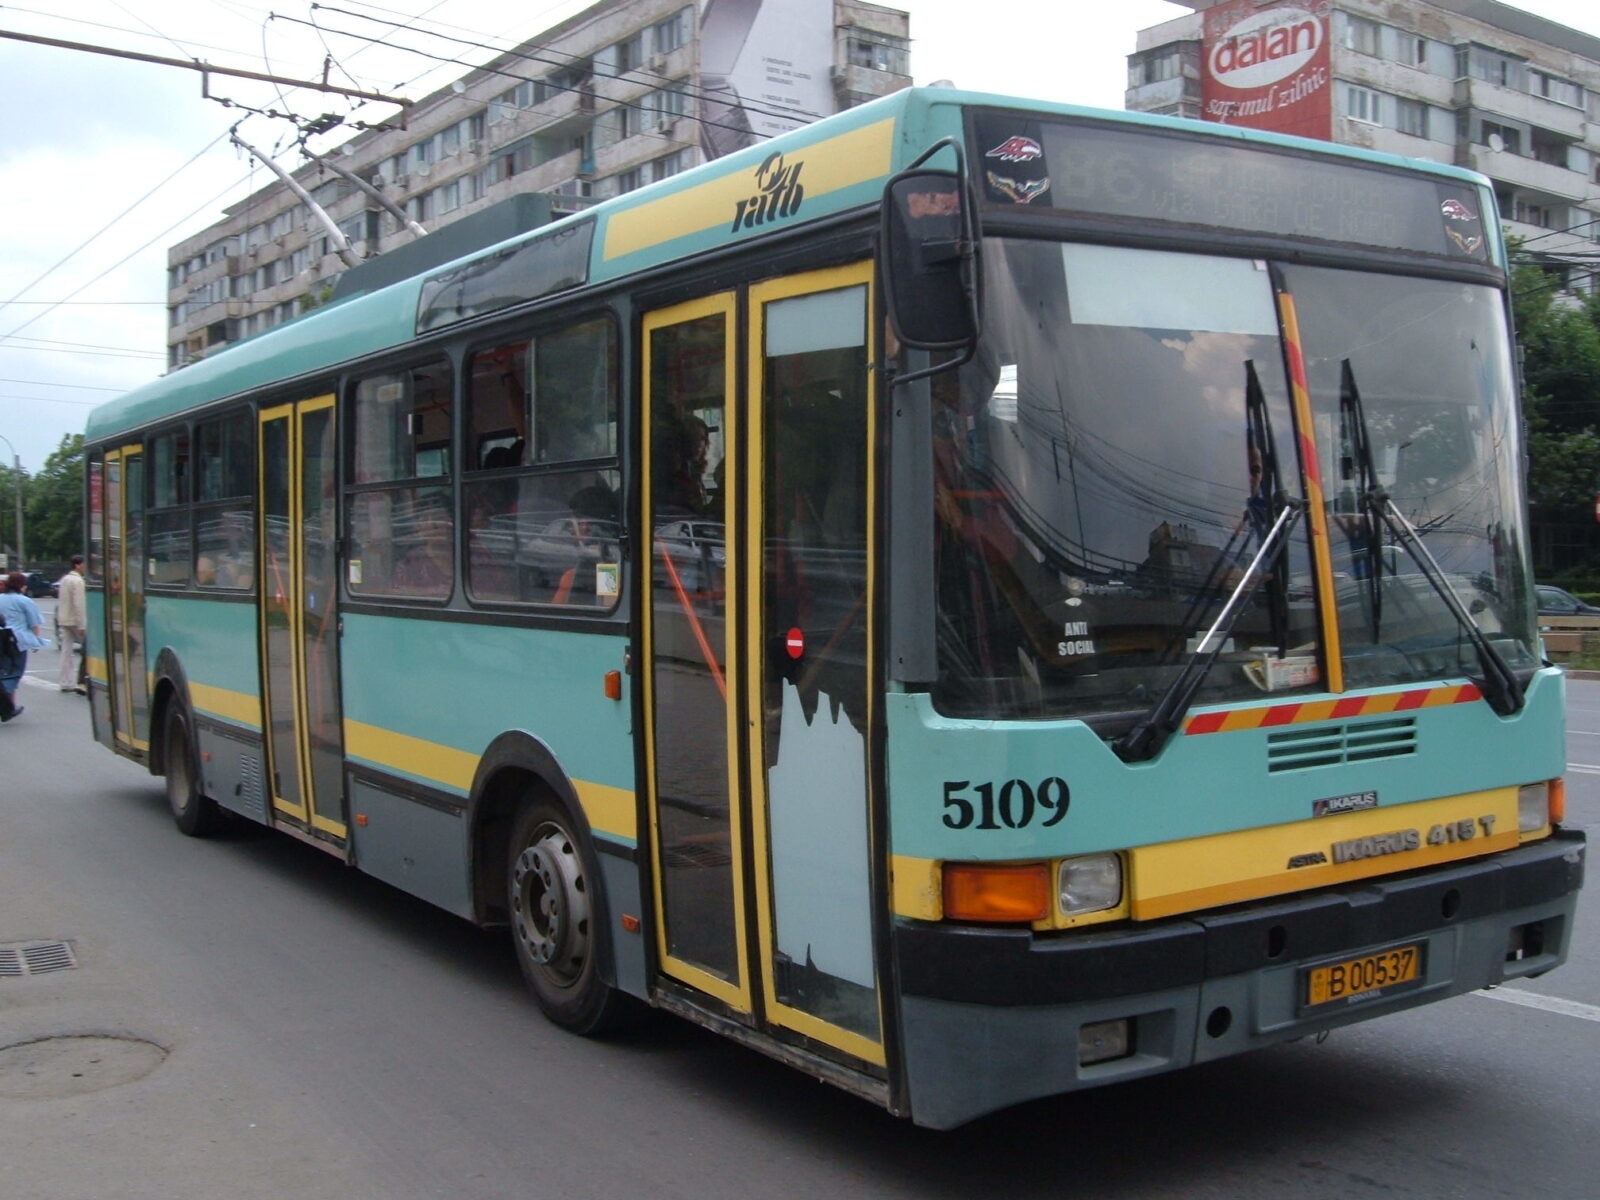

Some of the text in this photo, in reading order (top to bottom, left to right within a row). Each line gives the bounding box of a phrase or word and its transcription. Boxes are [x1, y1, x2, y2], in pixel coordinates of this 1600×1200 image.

[1278, 67, 1328, 108] zilnic
[1065, 621, 1088, 636] ANTI
[1058, 640, 1096, 656] SOCIAL
[942, 776, 1070, 830] 5109
[1329, 793, 1376, 809] IKARUS
[1331, 829, 1420, 865] IKARUS
[1427, 818, 1477, 846] 415
[1479, 814, 1496, 837] T
